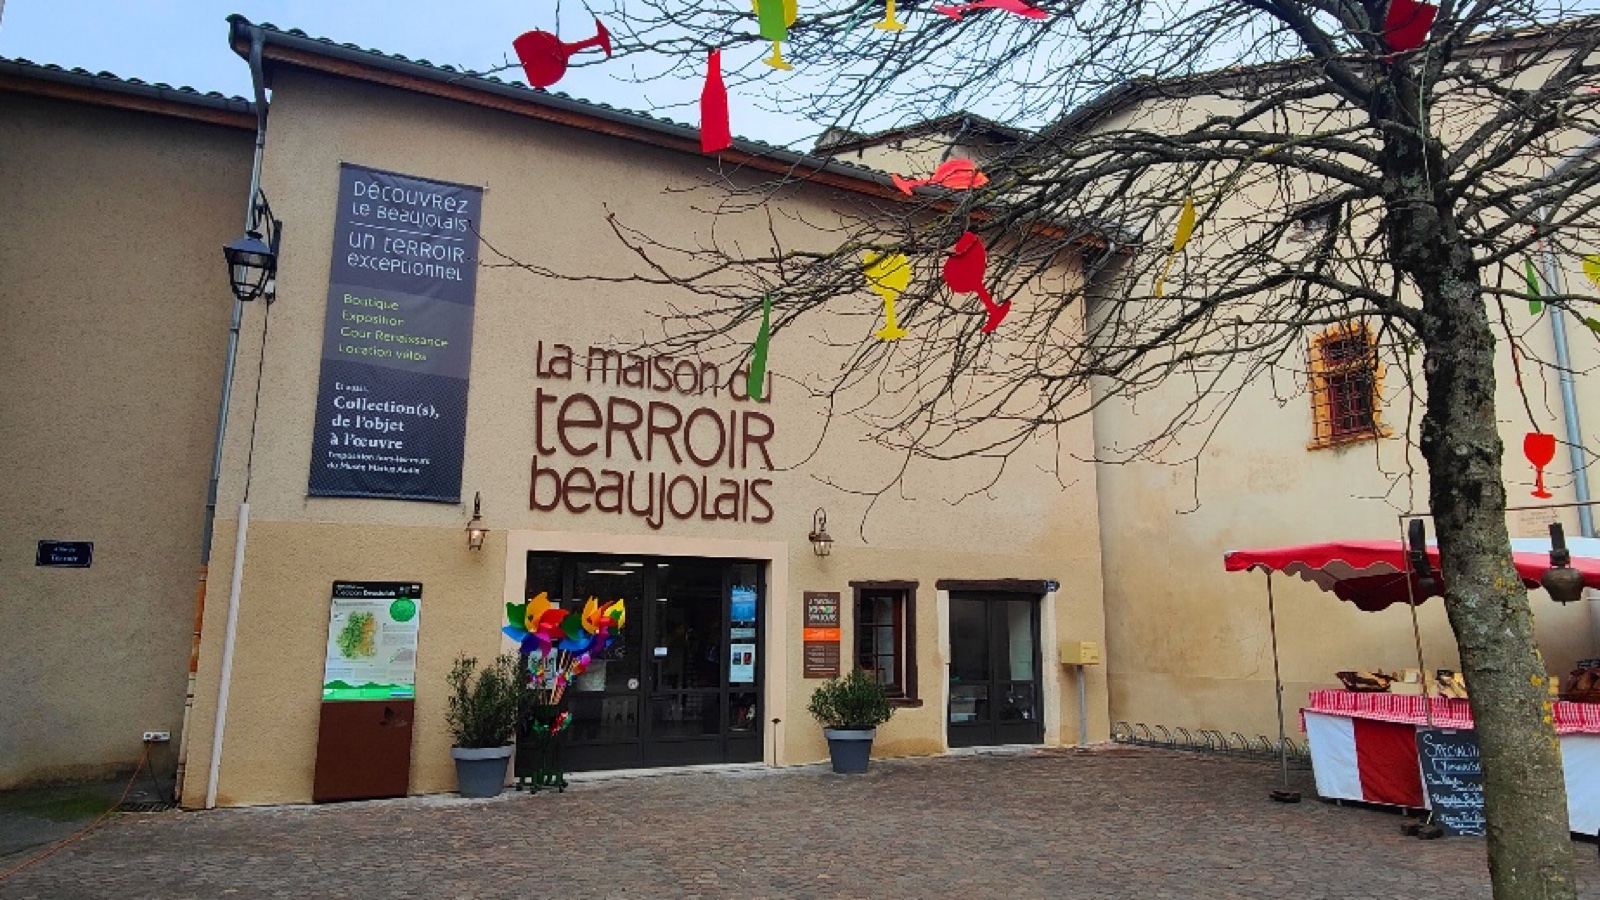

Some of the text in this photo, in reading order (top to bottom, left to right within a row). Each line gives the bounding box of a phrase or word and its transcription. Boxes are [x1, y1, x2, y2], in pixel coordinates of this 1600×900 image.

[343, 293, 399, 310] Boutique
[342, 310, 405, 327] Exposition
[340, 327, 449, 347] Cour Renaissance
[338, 343, 392, 358] Location
[333, 396, 439, 419] Collection(s),
[331, 414, 404, 433] de l'objet
[330, 432, 339, 446] à
